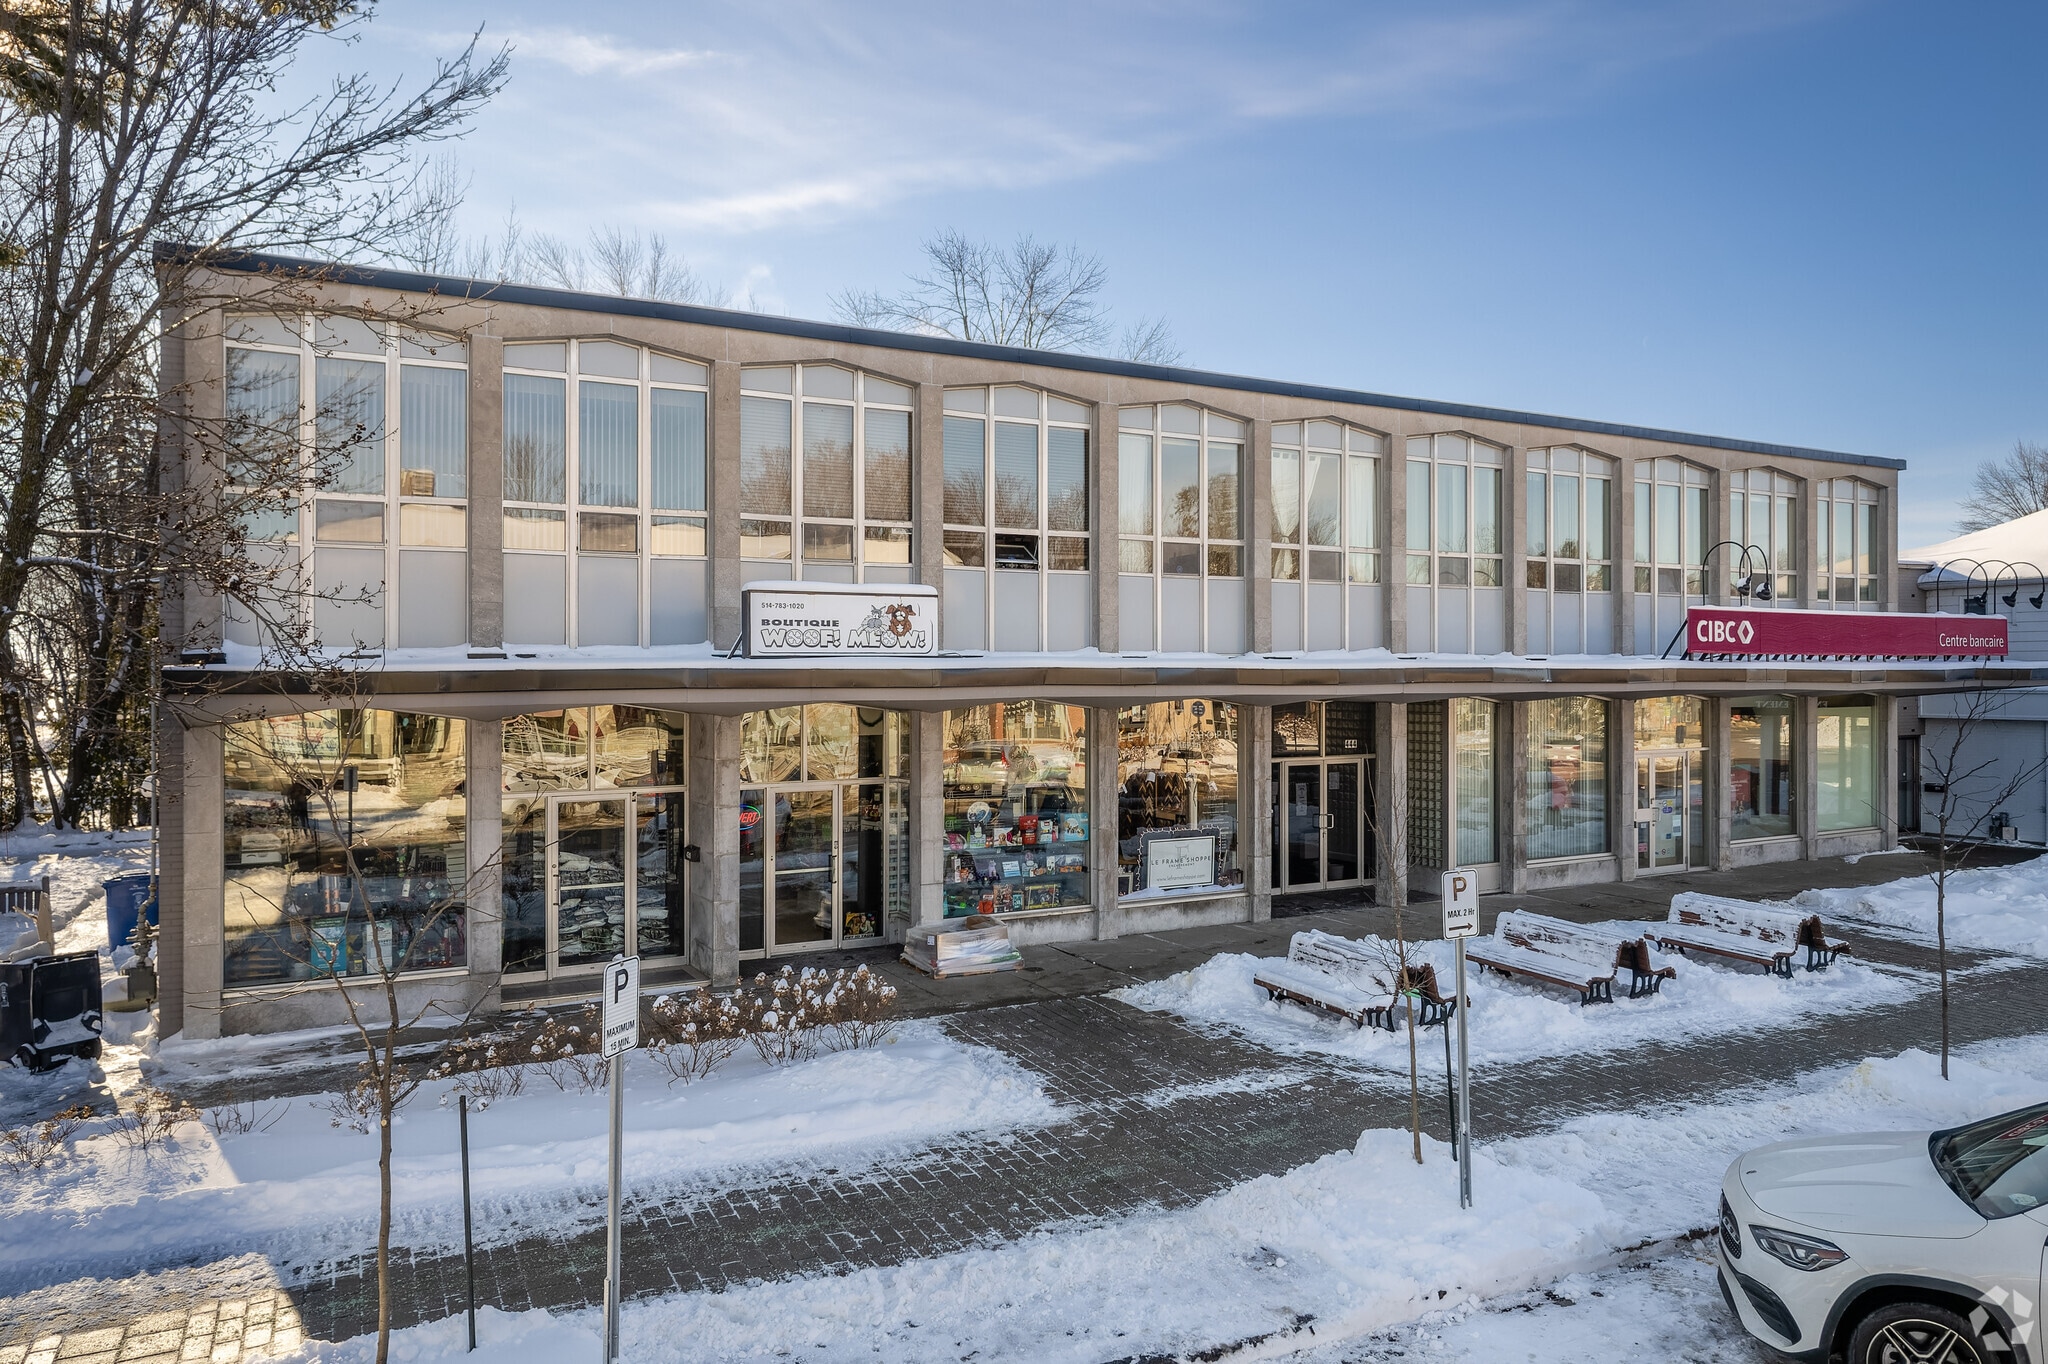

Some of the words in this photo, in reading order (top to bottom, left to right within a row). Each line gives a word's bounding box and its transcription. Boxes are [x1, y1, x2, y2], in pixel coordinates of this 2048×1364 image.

[761, 619, 840, 627] BOUTIQUE
[1696, 620, 1736, 643] CIBC
[760, 628, 841, 648] WOOF!
[847, 629, 926, 648] MEOW!
[1939, 633, 1968, 647] Centre
[1969, 633, 2004, 648] bancaire
[1190, 729, 1238, 741] SHOPPE
[1162, 857, 1184, 865] FRAME
[1186, 855, 1211, 863] SHOPPE
[1453, 877, 1467, 901] P
[614, 969, 628, 1004] P
[606, 1019, 635, 1038] MAXIMUM
